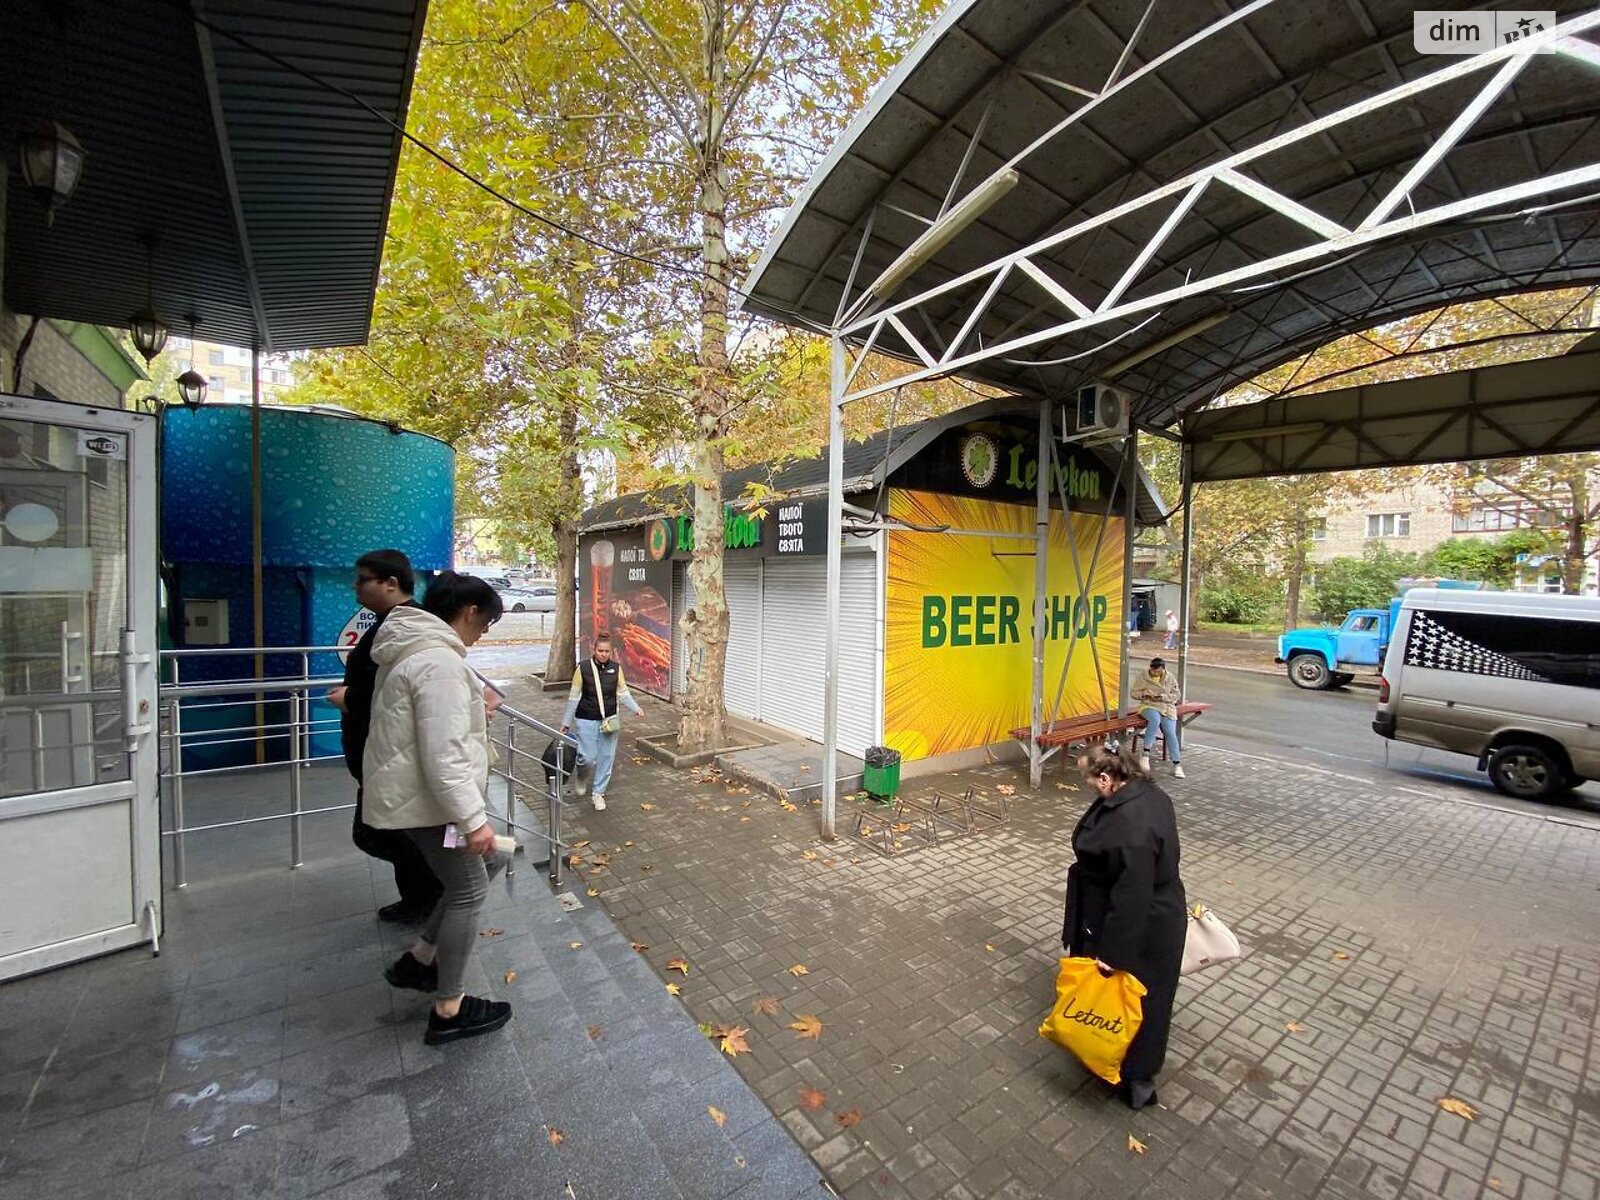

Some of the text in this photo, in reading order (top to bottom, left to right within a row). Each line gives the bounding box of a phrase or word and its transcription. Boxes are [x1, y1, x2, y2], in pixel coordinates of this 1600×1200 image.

[1005, 443, 1101, 501] Lerekon
[778, 522, 804, 537] ТВОГО
[778, 538, 804, 552] СВЯТА
[922, 595, 1020, 648] BEER
[1063, 997, 1123, 1034] Letout
